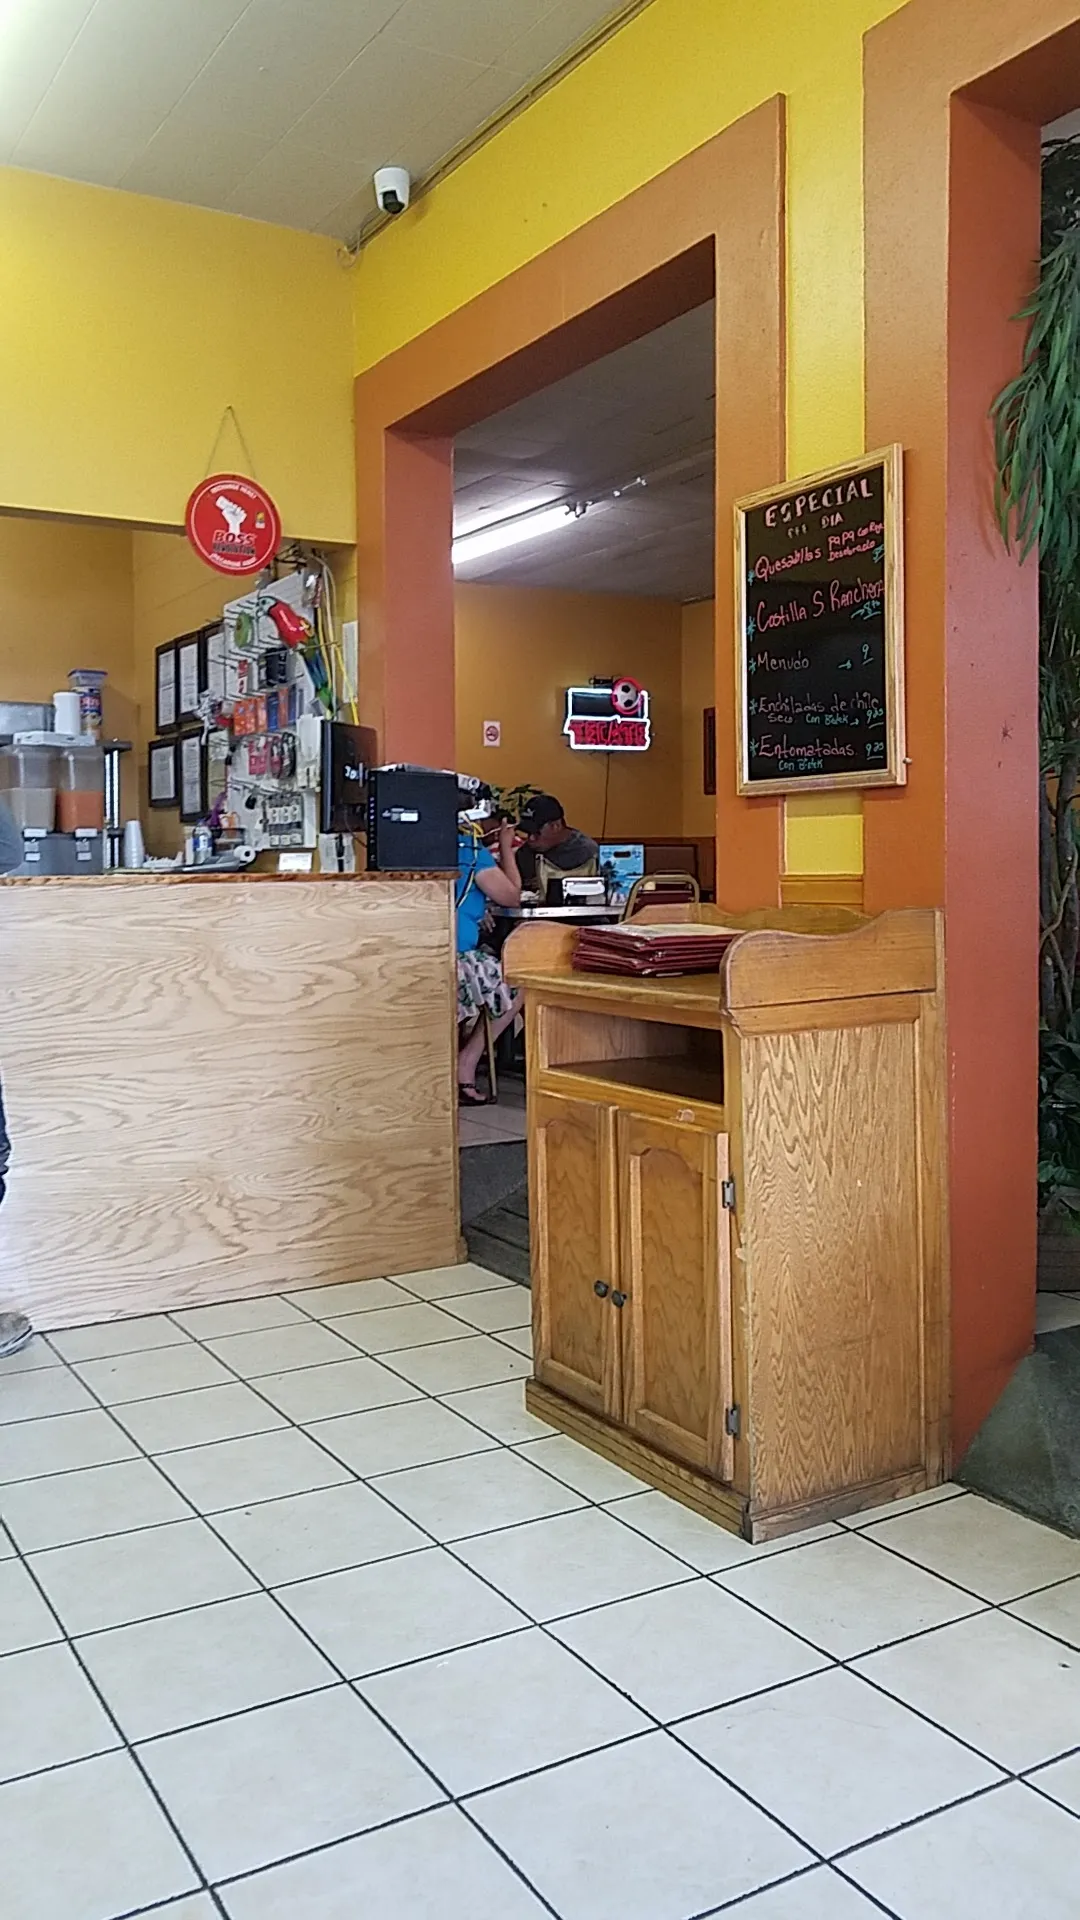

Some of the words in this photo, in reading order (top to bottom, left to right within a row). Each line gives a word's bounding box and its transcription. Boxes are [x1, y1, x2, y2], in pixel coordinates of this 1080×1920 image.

[765, 478, 874, 527] ESPECIAL
[821, 512, 845, 529] DIA
[212, 530, 257, 546] BOSS
[757, 650, 810, 672] Menudo
[758, 692, 826, 715] Enchiladas
[830, 693, 848, 712] de
[568, 720, 646, 746] TECATE
[758, 733, 855, 759] Entomatadas
